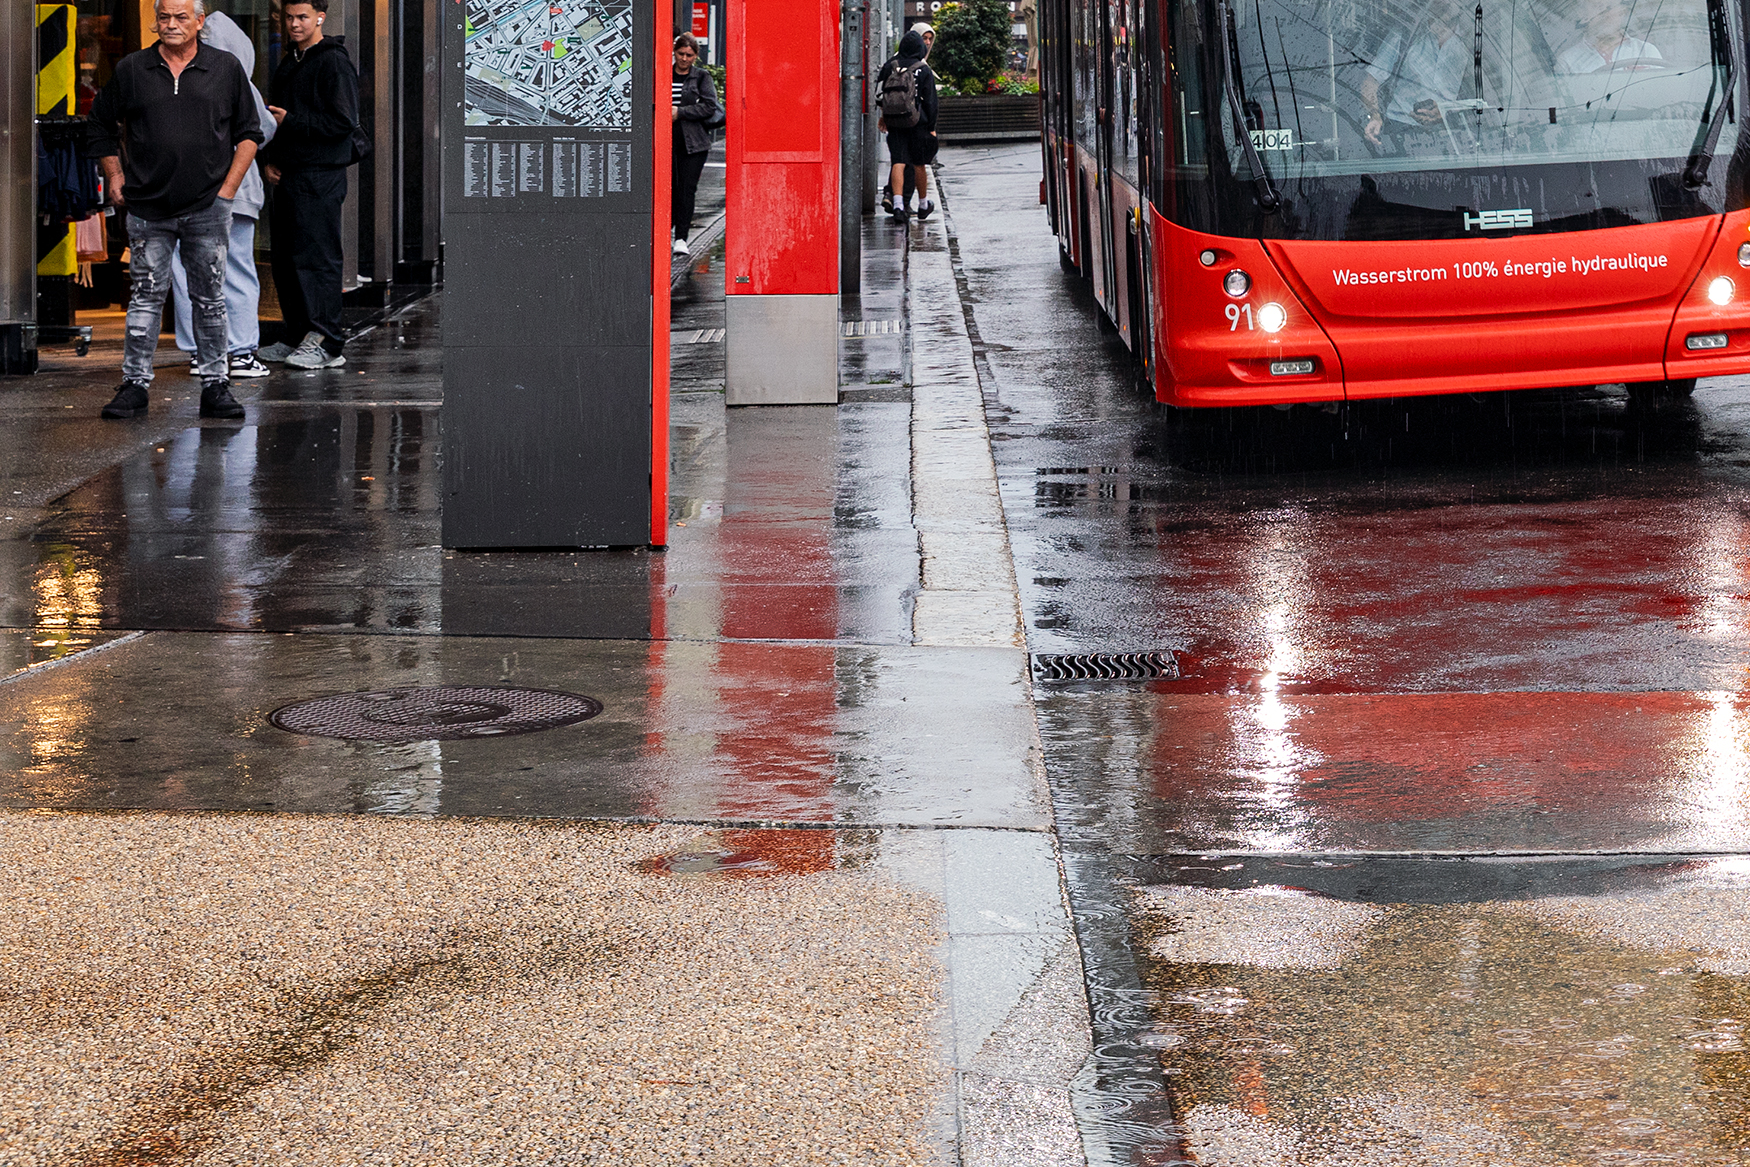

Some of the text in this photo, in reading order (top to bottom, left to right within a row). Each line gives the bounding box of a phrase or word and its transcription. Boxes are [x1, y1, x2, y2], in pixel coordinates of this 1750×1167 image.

[1252, 134, 1291, 148] 404
[1463, 208, 1533, 231] HESS
[1332, 253, 1668, 286] Wasserstrom 100% énergie hydraulique
[1225, 303, 1254, 331] 91
